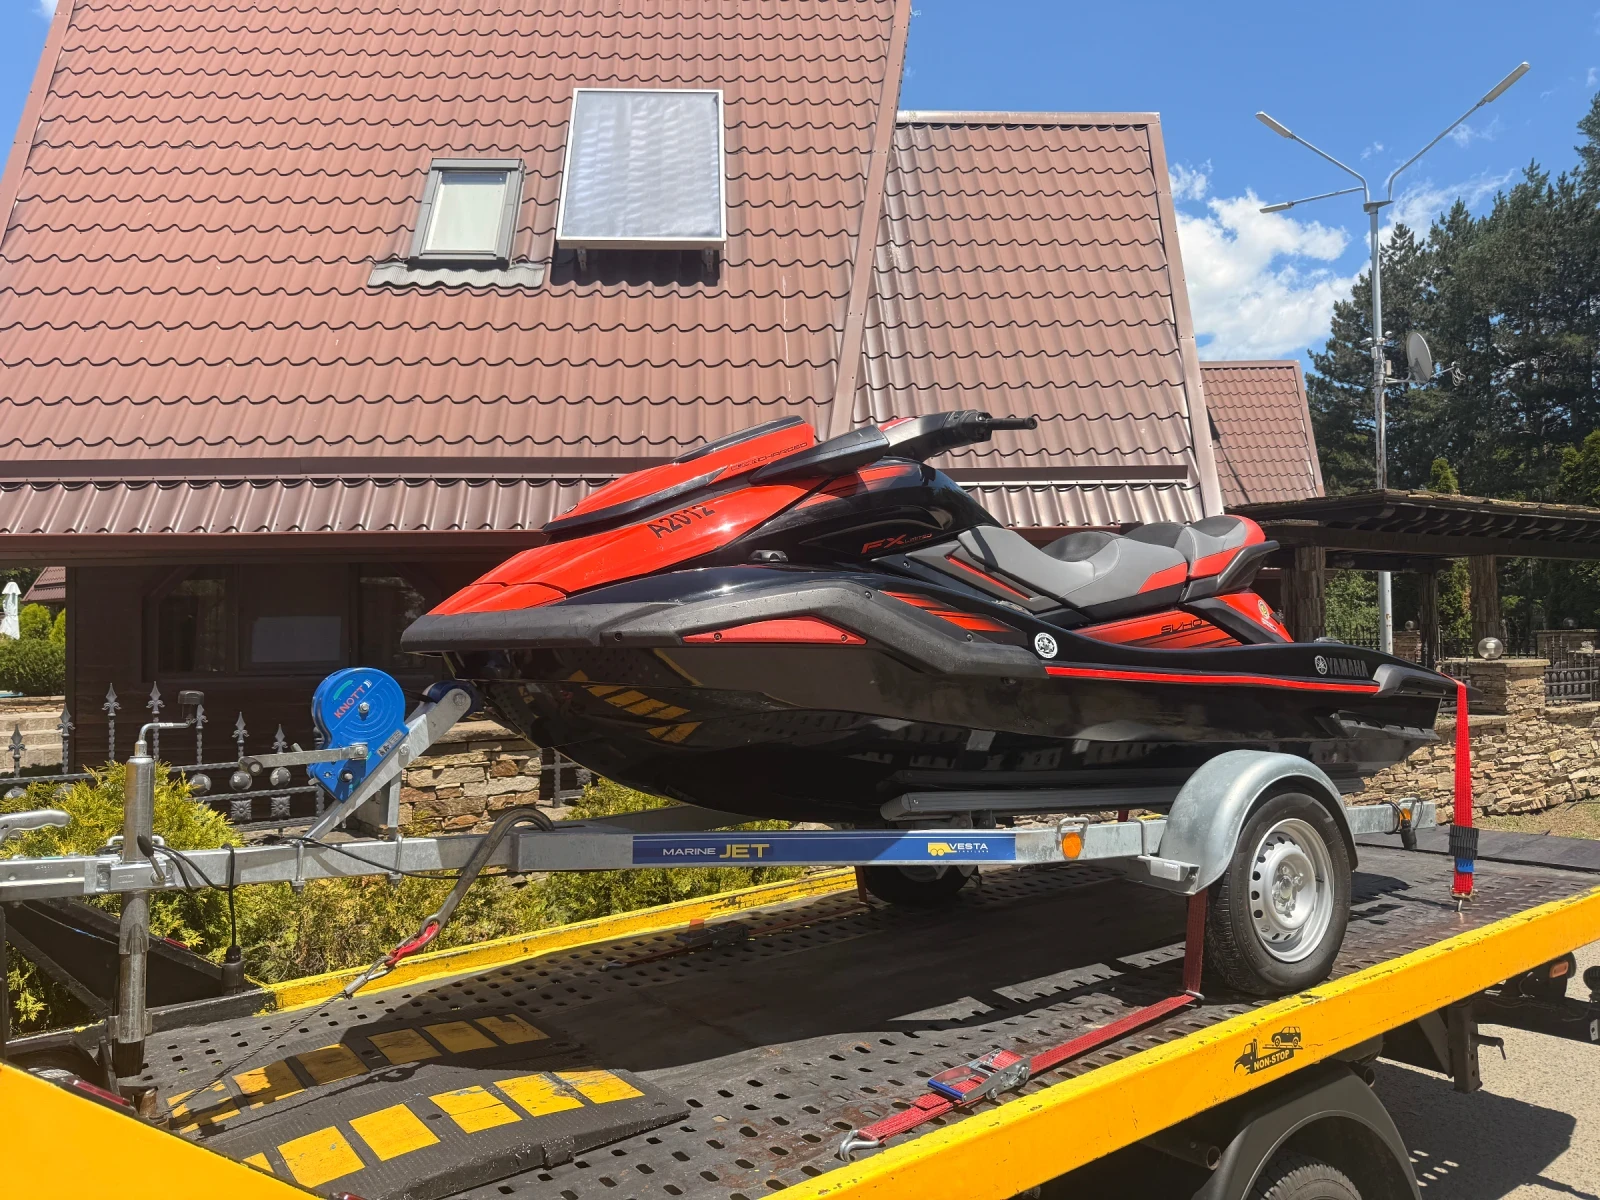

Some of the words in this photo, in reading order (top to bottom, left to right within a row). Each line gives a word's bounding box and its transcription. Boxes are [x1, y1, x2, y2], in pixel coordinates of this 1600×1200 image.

[646, 504, 716, 539] A2012
[861, 533, 907, 554] FX
[1161, 619, 1203, 633] SVHO
[1325, 657, 1369, 677] YAMAHA
[333, 685, 366, 719] KNOTT
[662, 847, 717, 856] MARINE
[719, 843, 770, 859] JET
[949, 842, 989, 850] VESTA
[1253, 1049, 1290, 1071] NON-STOP
